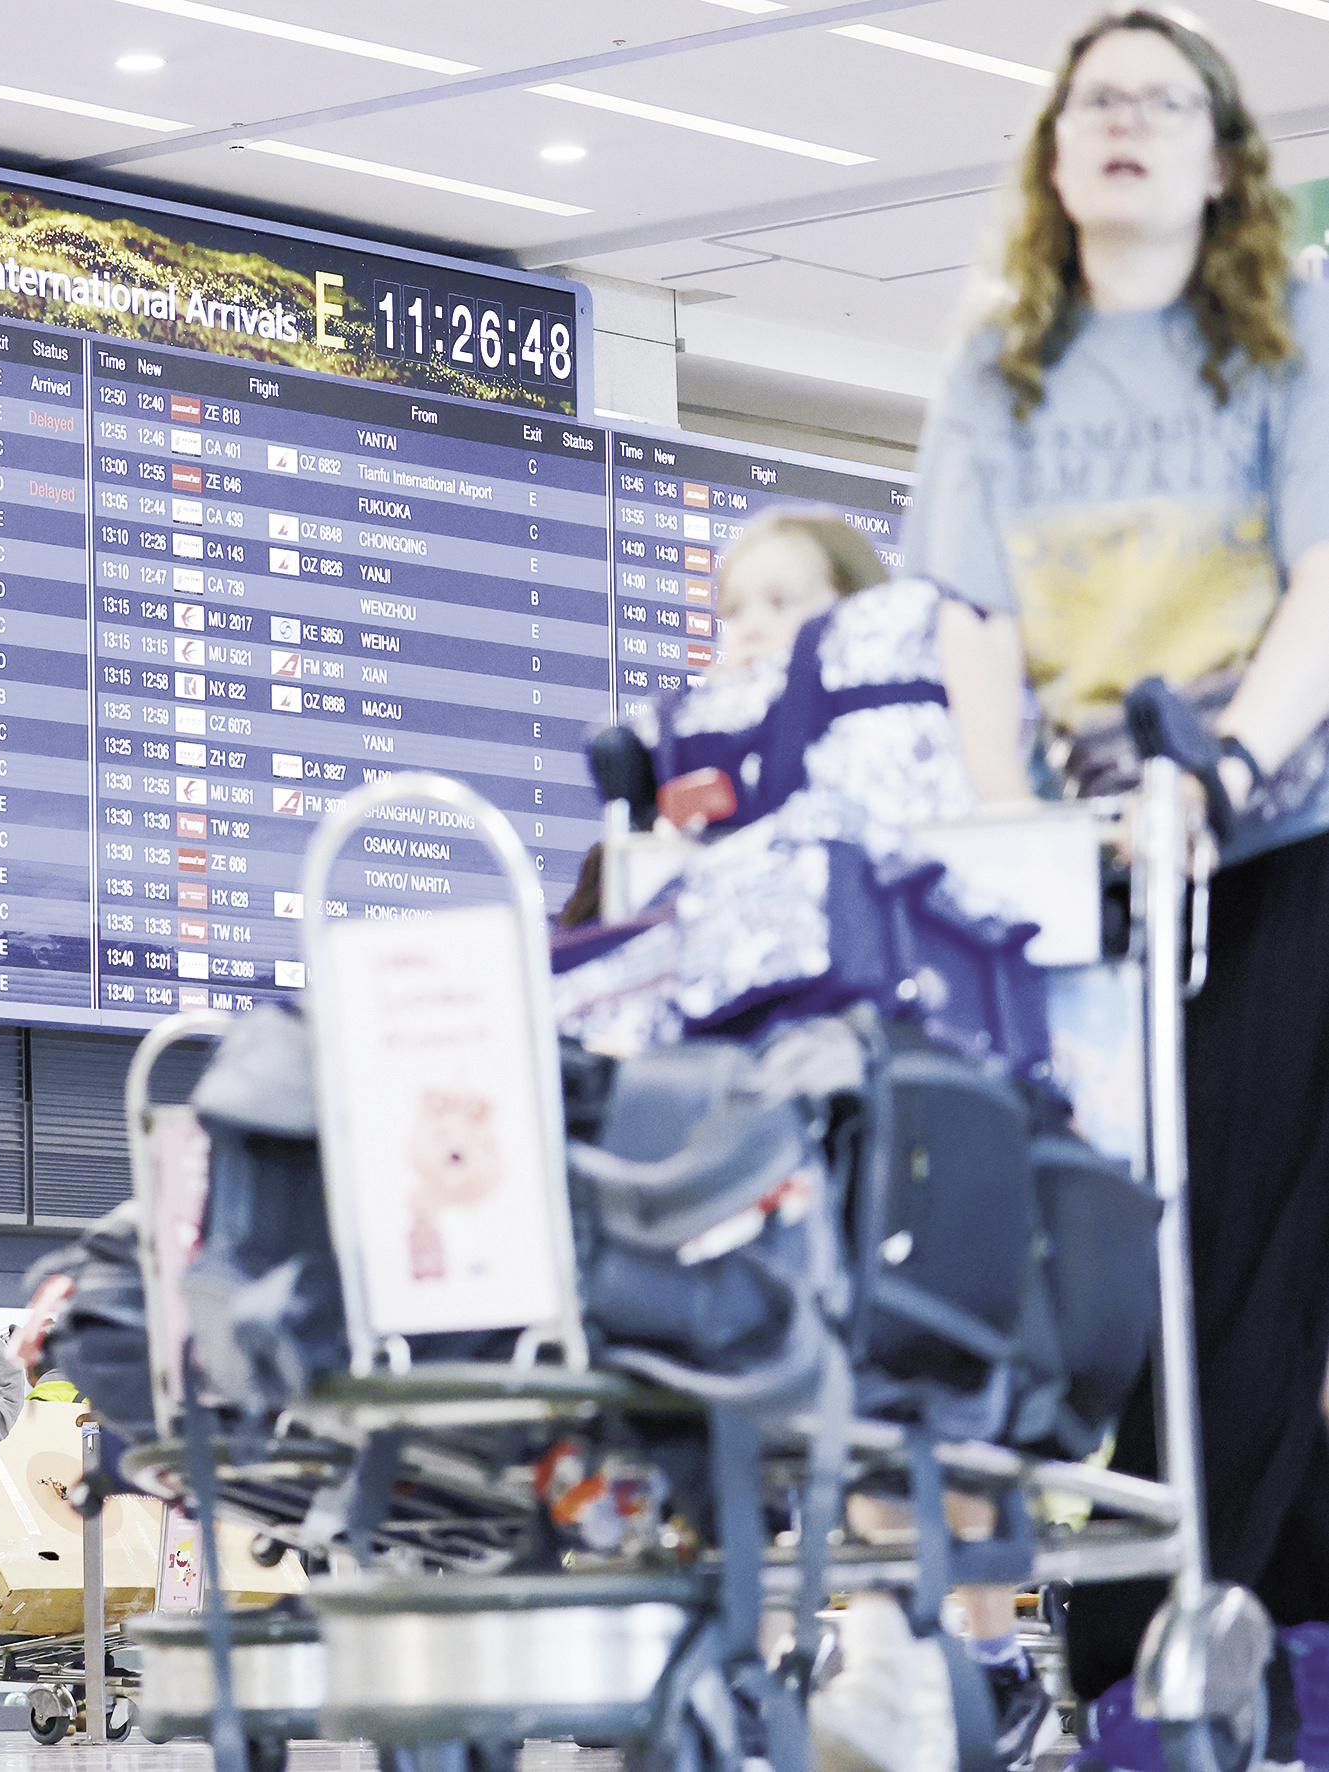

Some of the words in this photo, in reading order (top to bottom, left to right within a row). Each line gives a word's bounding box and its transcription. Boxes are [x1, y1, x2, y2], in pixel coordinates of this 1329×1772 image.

[184, 290, 299, 343] Arrivals
[315, 270, 347, 349] E
[378, 292, 571, 380] 11:26:48
[33, 340, 68, 360] Status
[31, 375, 70, 396] Arrived
[98, 352, 125, 370] Time
[138, 359, 162, 376] New
[250, 378, 279, 398] Flight
[412, 406, 437, 424] From
[524, 425, 542, 442] Exit
[563, 432, 593, 451] Status
[100, 387, 126, 405] 12:50
[138, 393, 164, 412] 12:40
[29, 410, 74, 433] Delayed
[205, 405, 219, 421] ZE
[223, 408, 240, 425] 818
[357, 430, 396, 450] YANTAI
[357, 463, 390, 483] Tianfu
[393, 469, 456, 494] International
[458, 480, 492, 500] Airport
[620, 442, 643, 459] Time
[655, 448, 675, 465] New
[752, 466, 776, 485] Flight
[891, 490, 914, 507] From
[30, 480, 75, 503] Delayed
[621, 475, 643, 492] 13:45
[654, 481, 677, 498] 13:45
[359, 498, 411, 520] FUKUOKA
[712, 491, 725, 506] 7C
[728, 493, 747, 510] 1404
[845, 513, 890, 534] FUKUOKA
[359, 531, 427, 556] CHONGQING
[360, 565, 390, 583] YANJI
[360, 598, 416, 621] WENZHOU
[303, 624, 318, 641] KE
[321, 627, 343, 644] 5850
[361, 633, 399, 652] WEIHAI
[361, 666, 387, 684] XIAN
[362, 700, 401, 719] MACAU
[428, 809, 475, 830] PUDONG
[364, 836, 407, 857] OSAKA/
[410, 841, 449, 860] KANSAI
[364, 870, 408, 891] TOKYO/
[411, 875, 451, 894] NARITA
[145, 987, 172, 1005] 13:40
